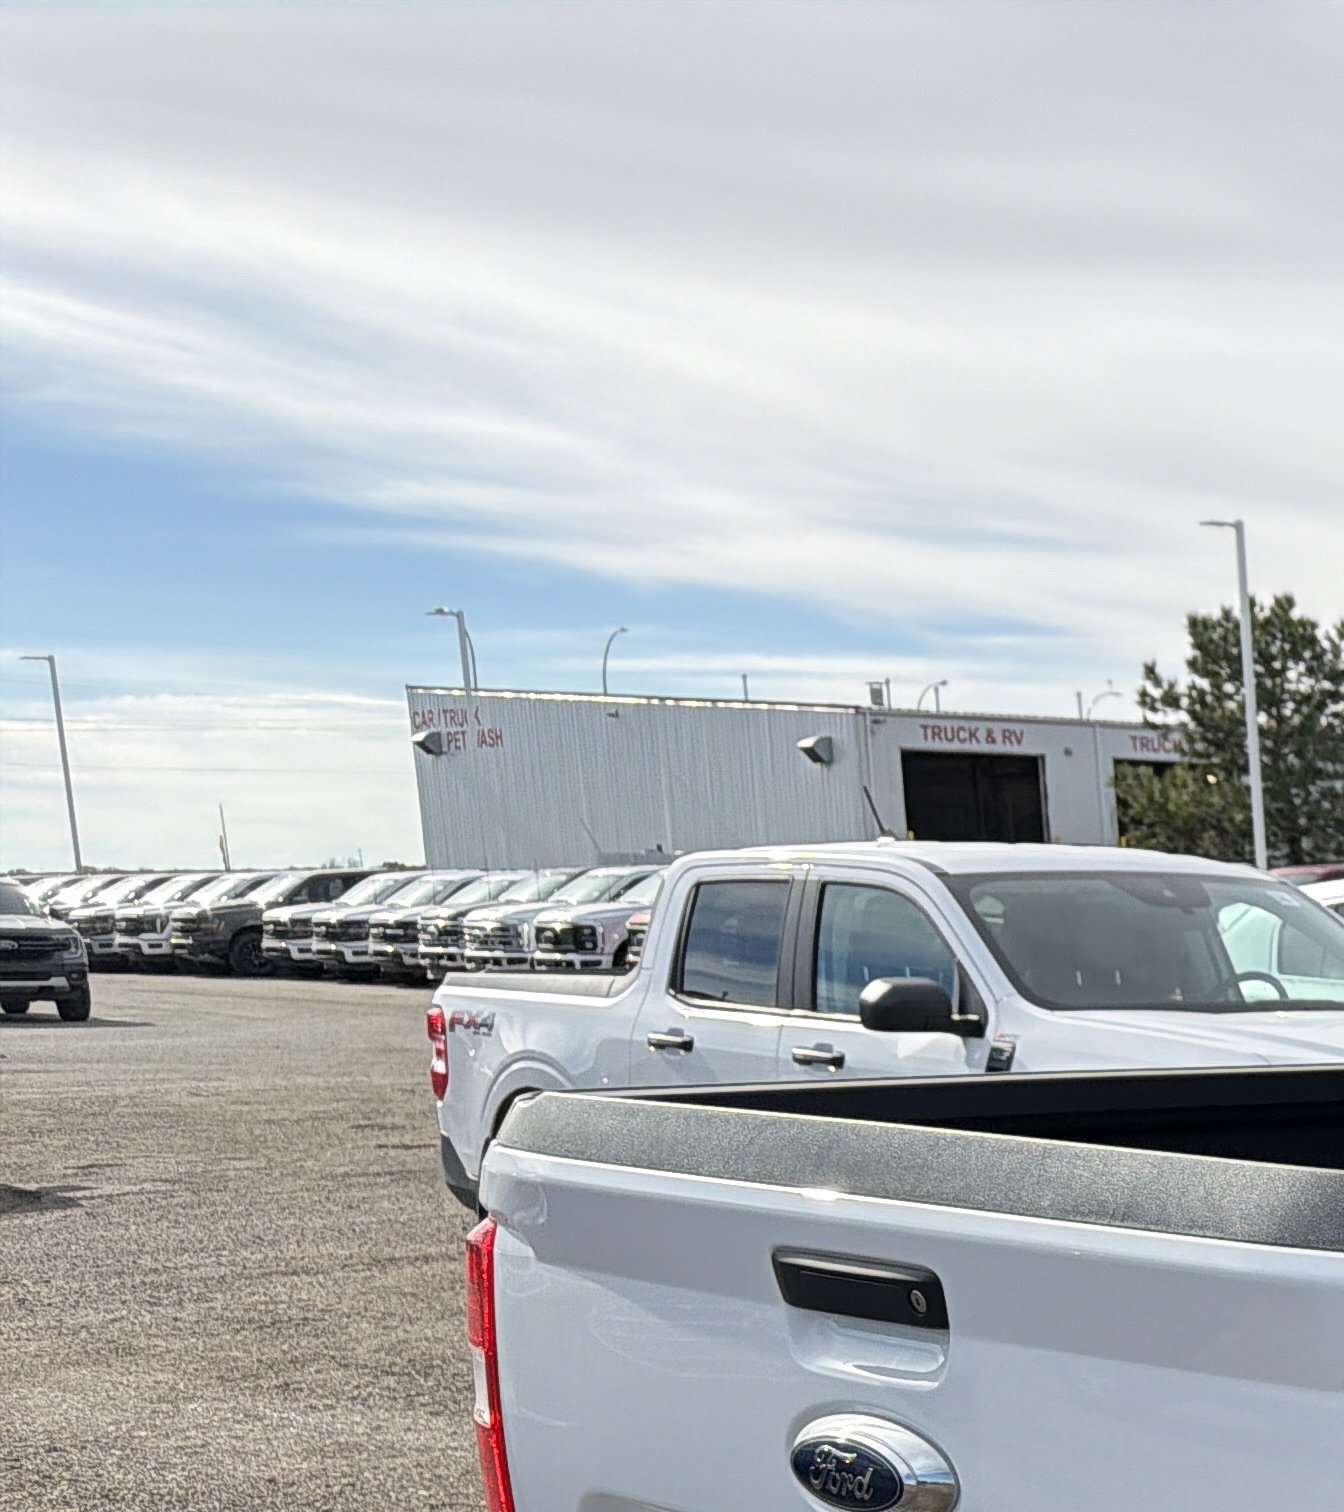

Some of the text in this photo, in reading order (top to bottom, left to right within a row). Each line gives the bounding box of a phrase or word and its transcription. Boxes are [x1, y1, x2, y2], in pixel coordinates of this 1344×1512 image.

[920, 724, 1024, 747] TRUCK & RV
[809, 1444, 875, 1501] Ford
